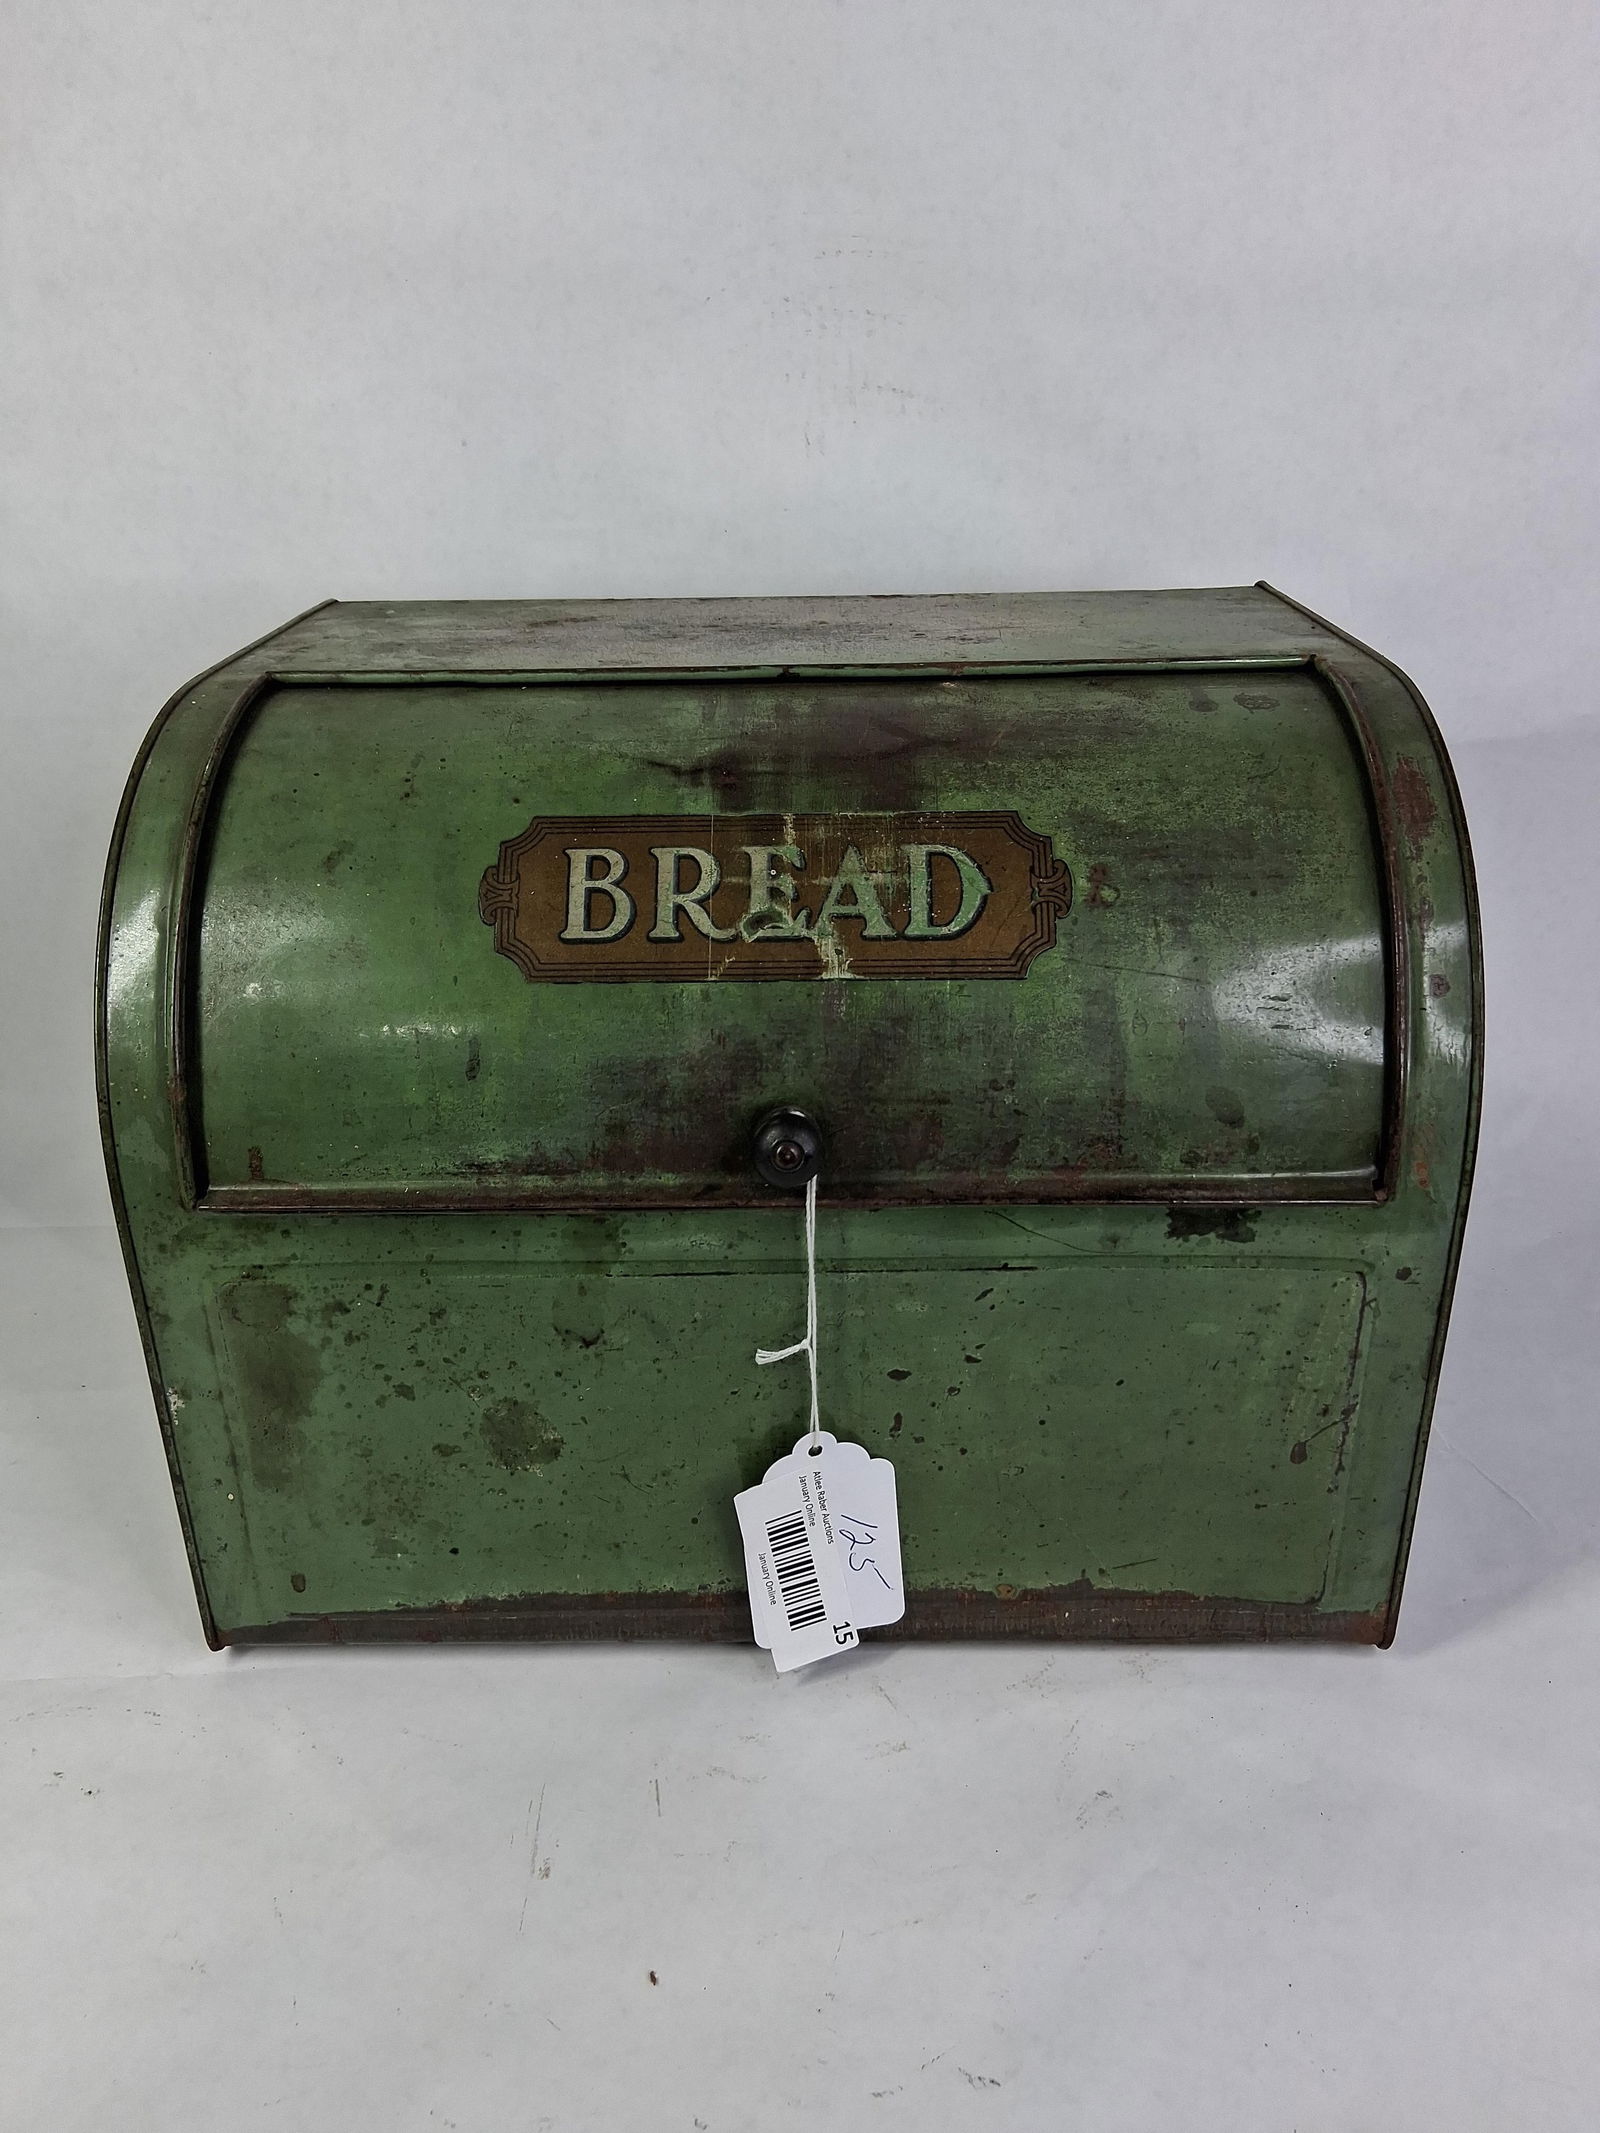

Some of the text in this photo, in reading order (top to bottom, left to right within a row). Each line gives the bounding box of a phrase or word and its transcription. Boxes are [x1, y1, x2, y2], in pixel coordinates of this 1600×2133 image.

[559, 845, 993, 943] BREAD
[799, 1475, 816, 1527] January Online
[813, 1471, 834, 1544] Atlee Raber Auctions
[758, 1552, 777, 1605] January Online
[832, 1621, 854, 1645] 15
